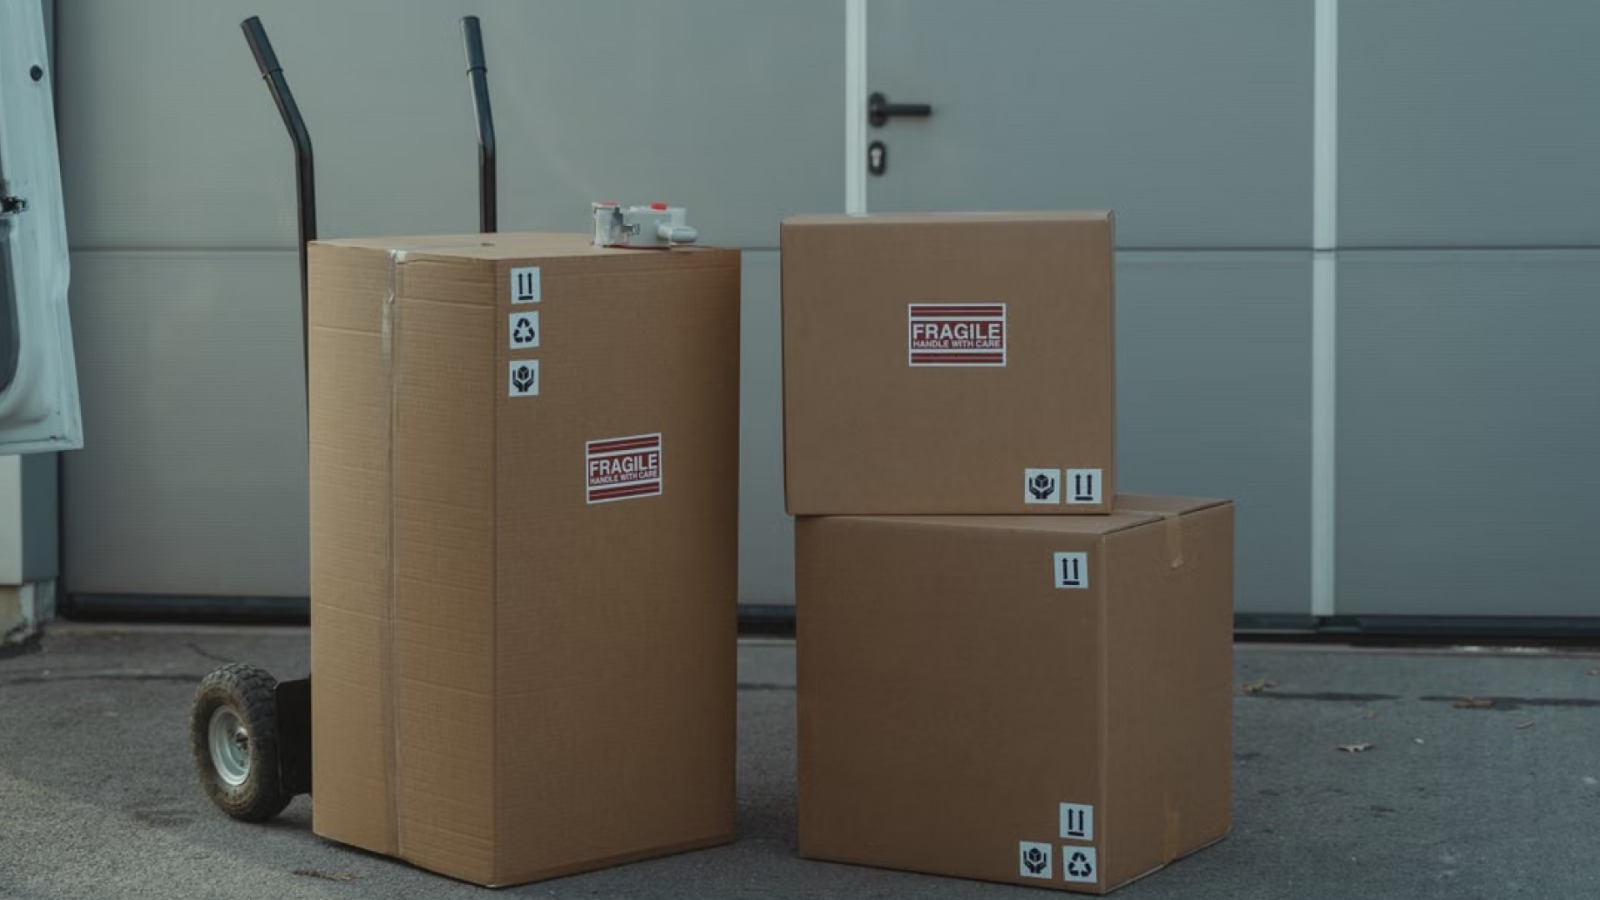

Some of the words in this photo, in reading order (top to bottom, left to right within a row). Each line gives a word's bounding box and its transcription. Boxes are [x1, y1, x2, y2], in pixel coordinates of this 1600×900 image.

[913, 323, 1000, 339] FRAGILE
[913, 340, 949, 348] HANDLE
[951, 340, 974, 348] WITH
[976, 340, 1000, 348] CARE
[590, 453, 657, 477] FRAGILE
[590, 474, 618, 485] HANDLE
[620, 472, 637, 481] WITH
[638, 469, 657, 479] CARE
